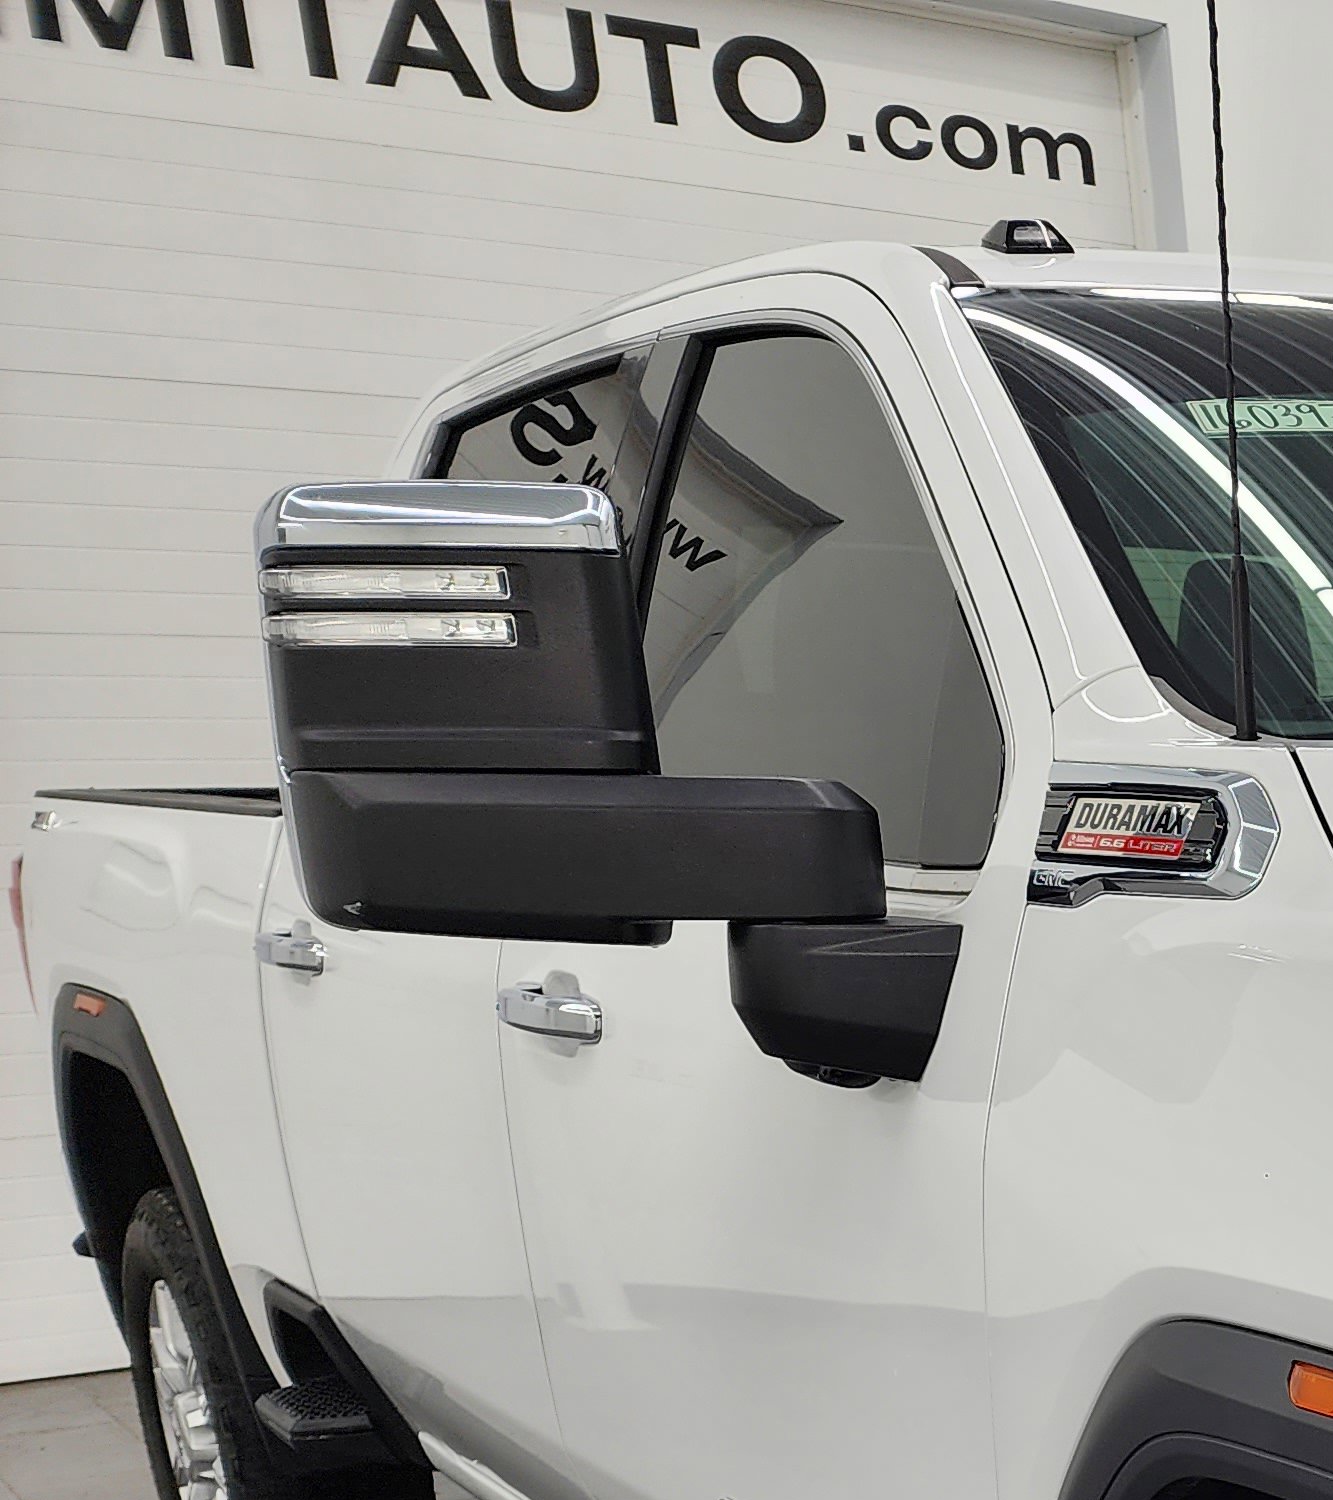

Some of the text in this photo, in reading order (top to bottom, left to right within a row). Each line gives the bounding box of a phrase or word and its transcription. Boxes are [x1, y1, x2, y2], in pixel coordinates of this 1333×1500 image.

[1075, 802, 1192, 835] DURAMAX
[1098, 837, 1126, 849] 6.6
[1129, 839, 1176, 853] LITER
